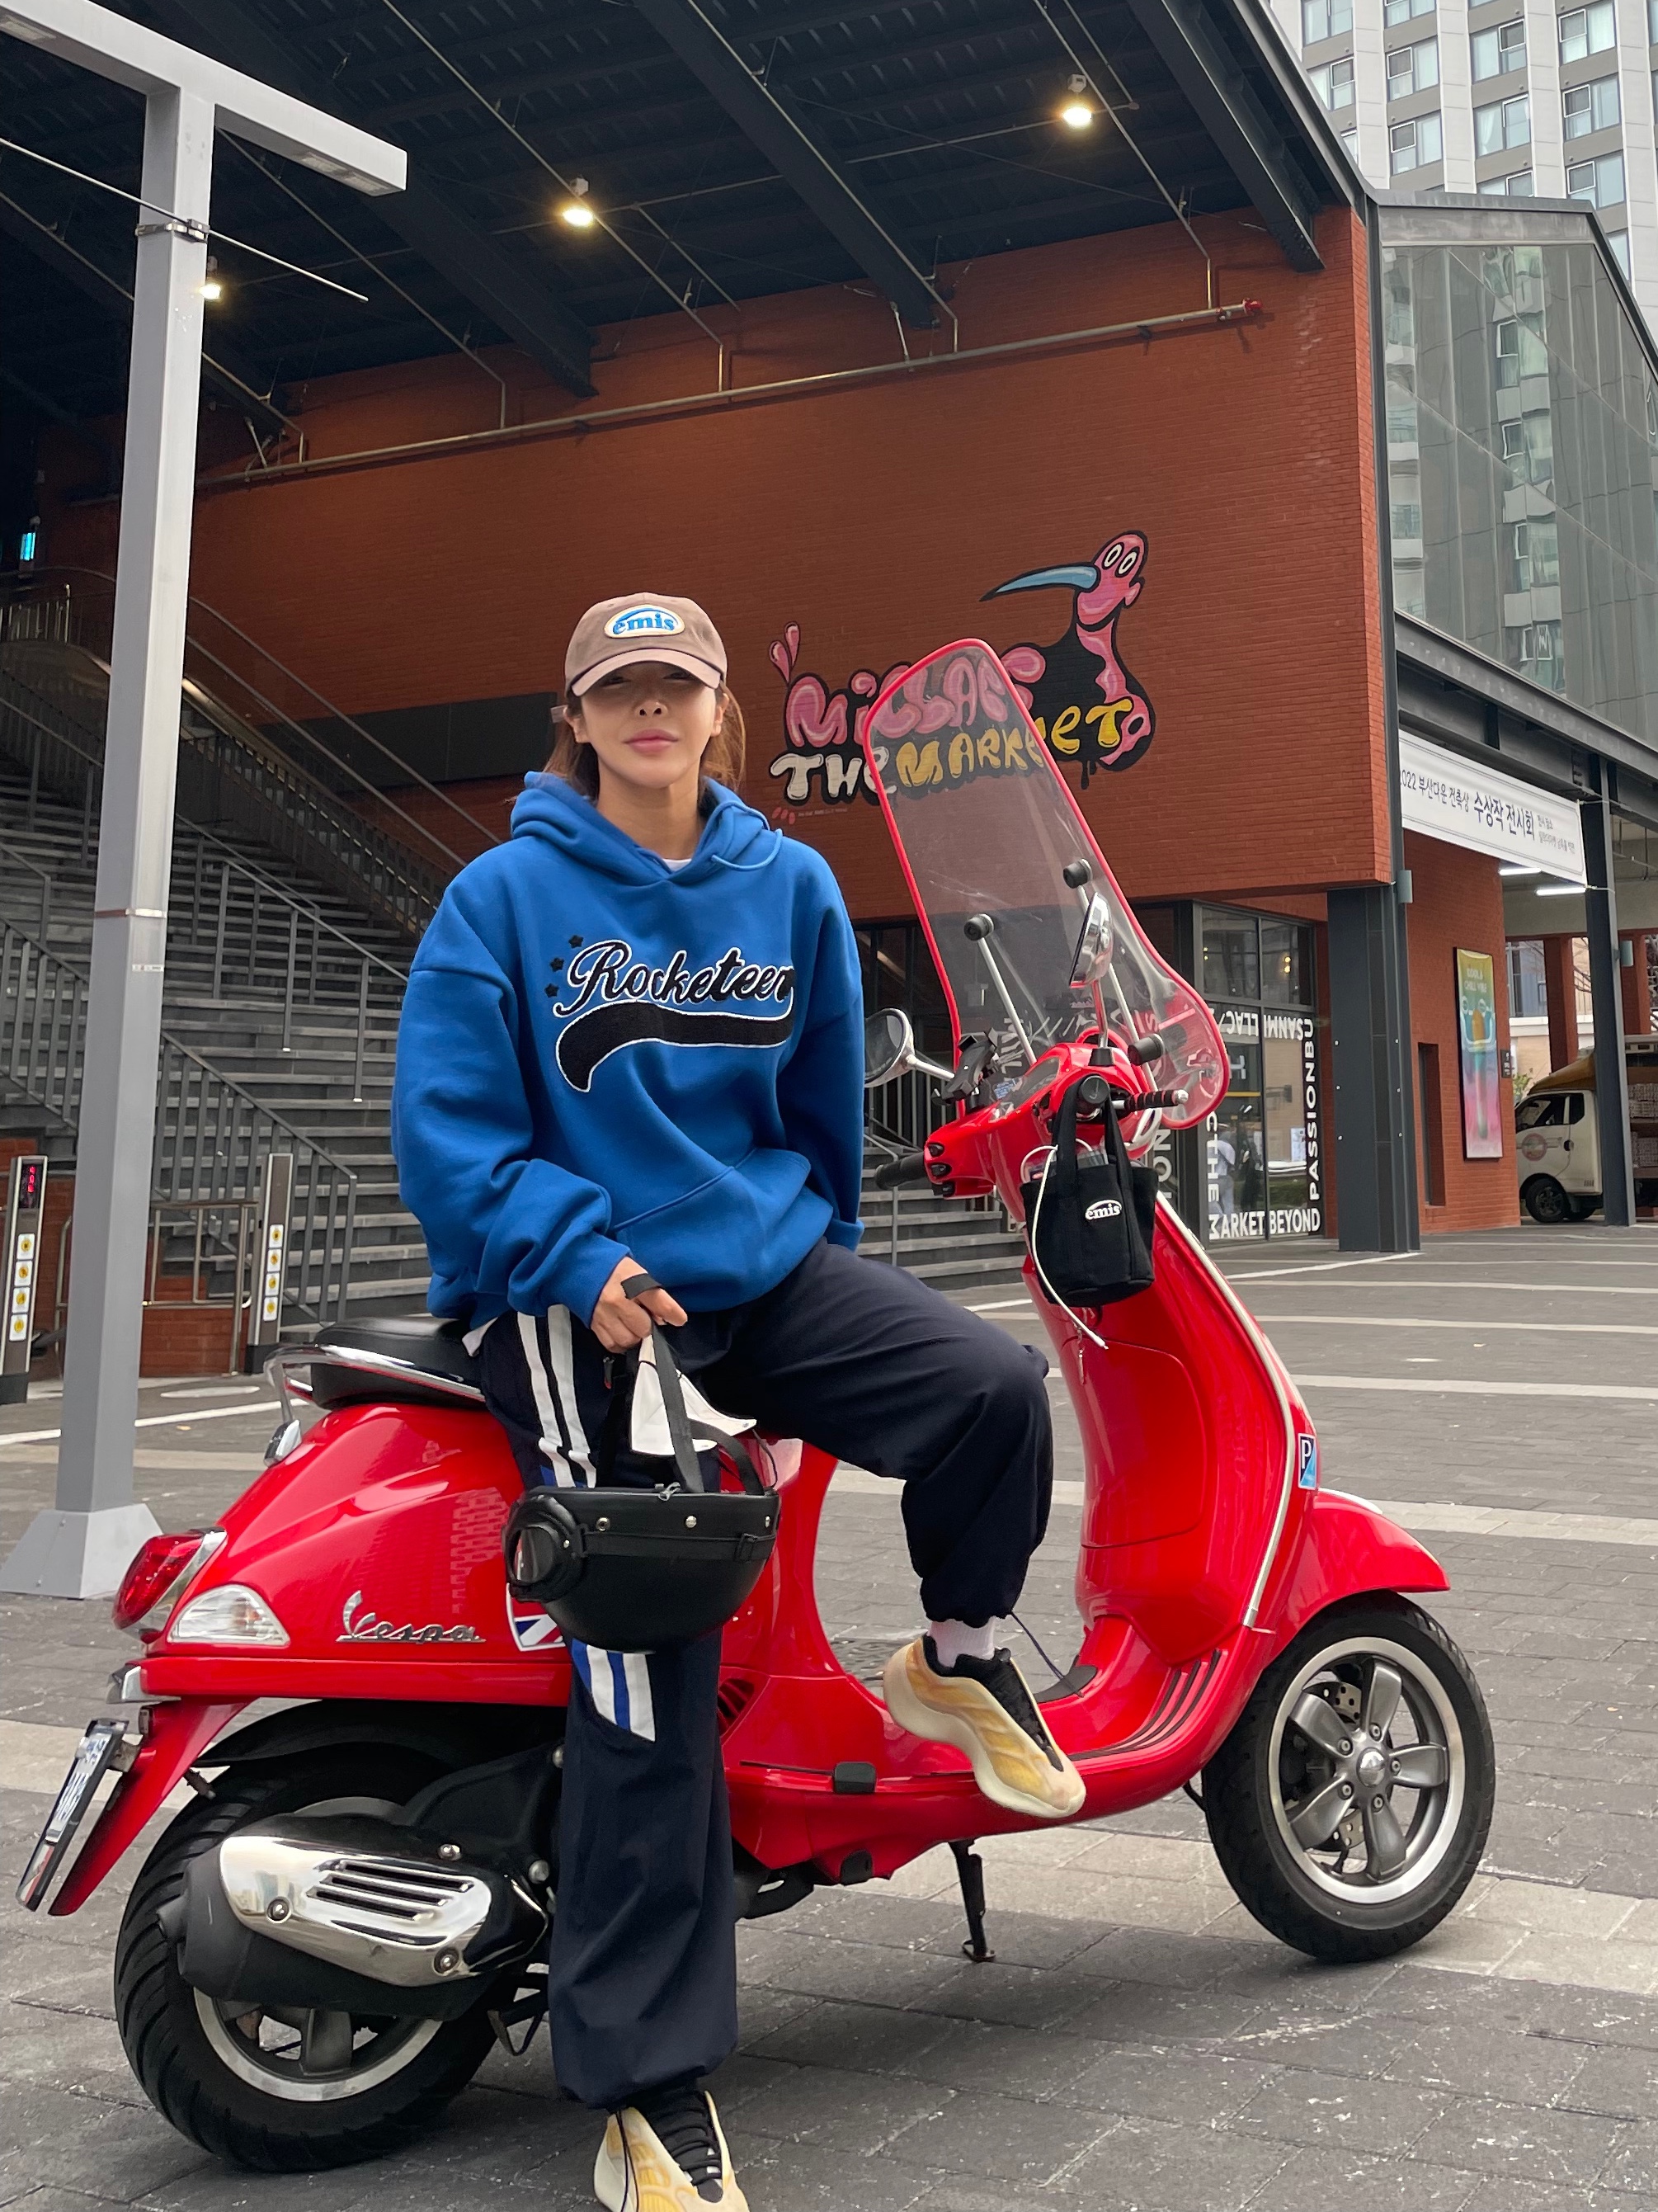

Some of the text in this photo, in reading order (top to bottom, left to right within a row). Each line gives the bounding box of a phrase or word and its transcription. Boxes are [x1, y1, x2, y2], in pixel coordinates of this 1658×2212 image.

[612, 611, 676, 634] emis
[1400, 769, 1416, 791] 022
[1473, 791, 1504, 832] 수상작
[1505, 804, 1535, 842] 전시회
[553, 939, 795, 1018] Rocketeer
[1304, 1062, 1321, 1201] PASSION
[1207, 1134, 1221, 1203] THE
[1086, 1202, 1122, 1220] emis
[1269, 1207, 1321, 1234] BEYOND
[336, 1590, 487, 1644] Vespa
